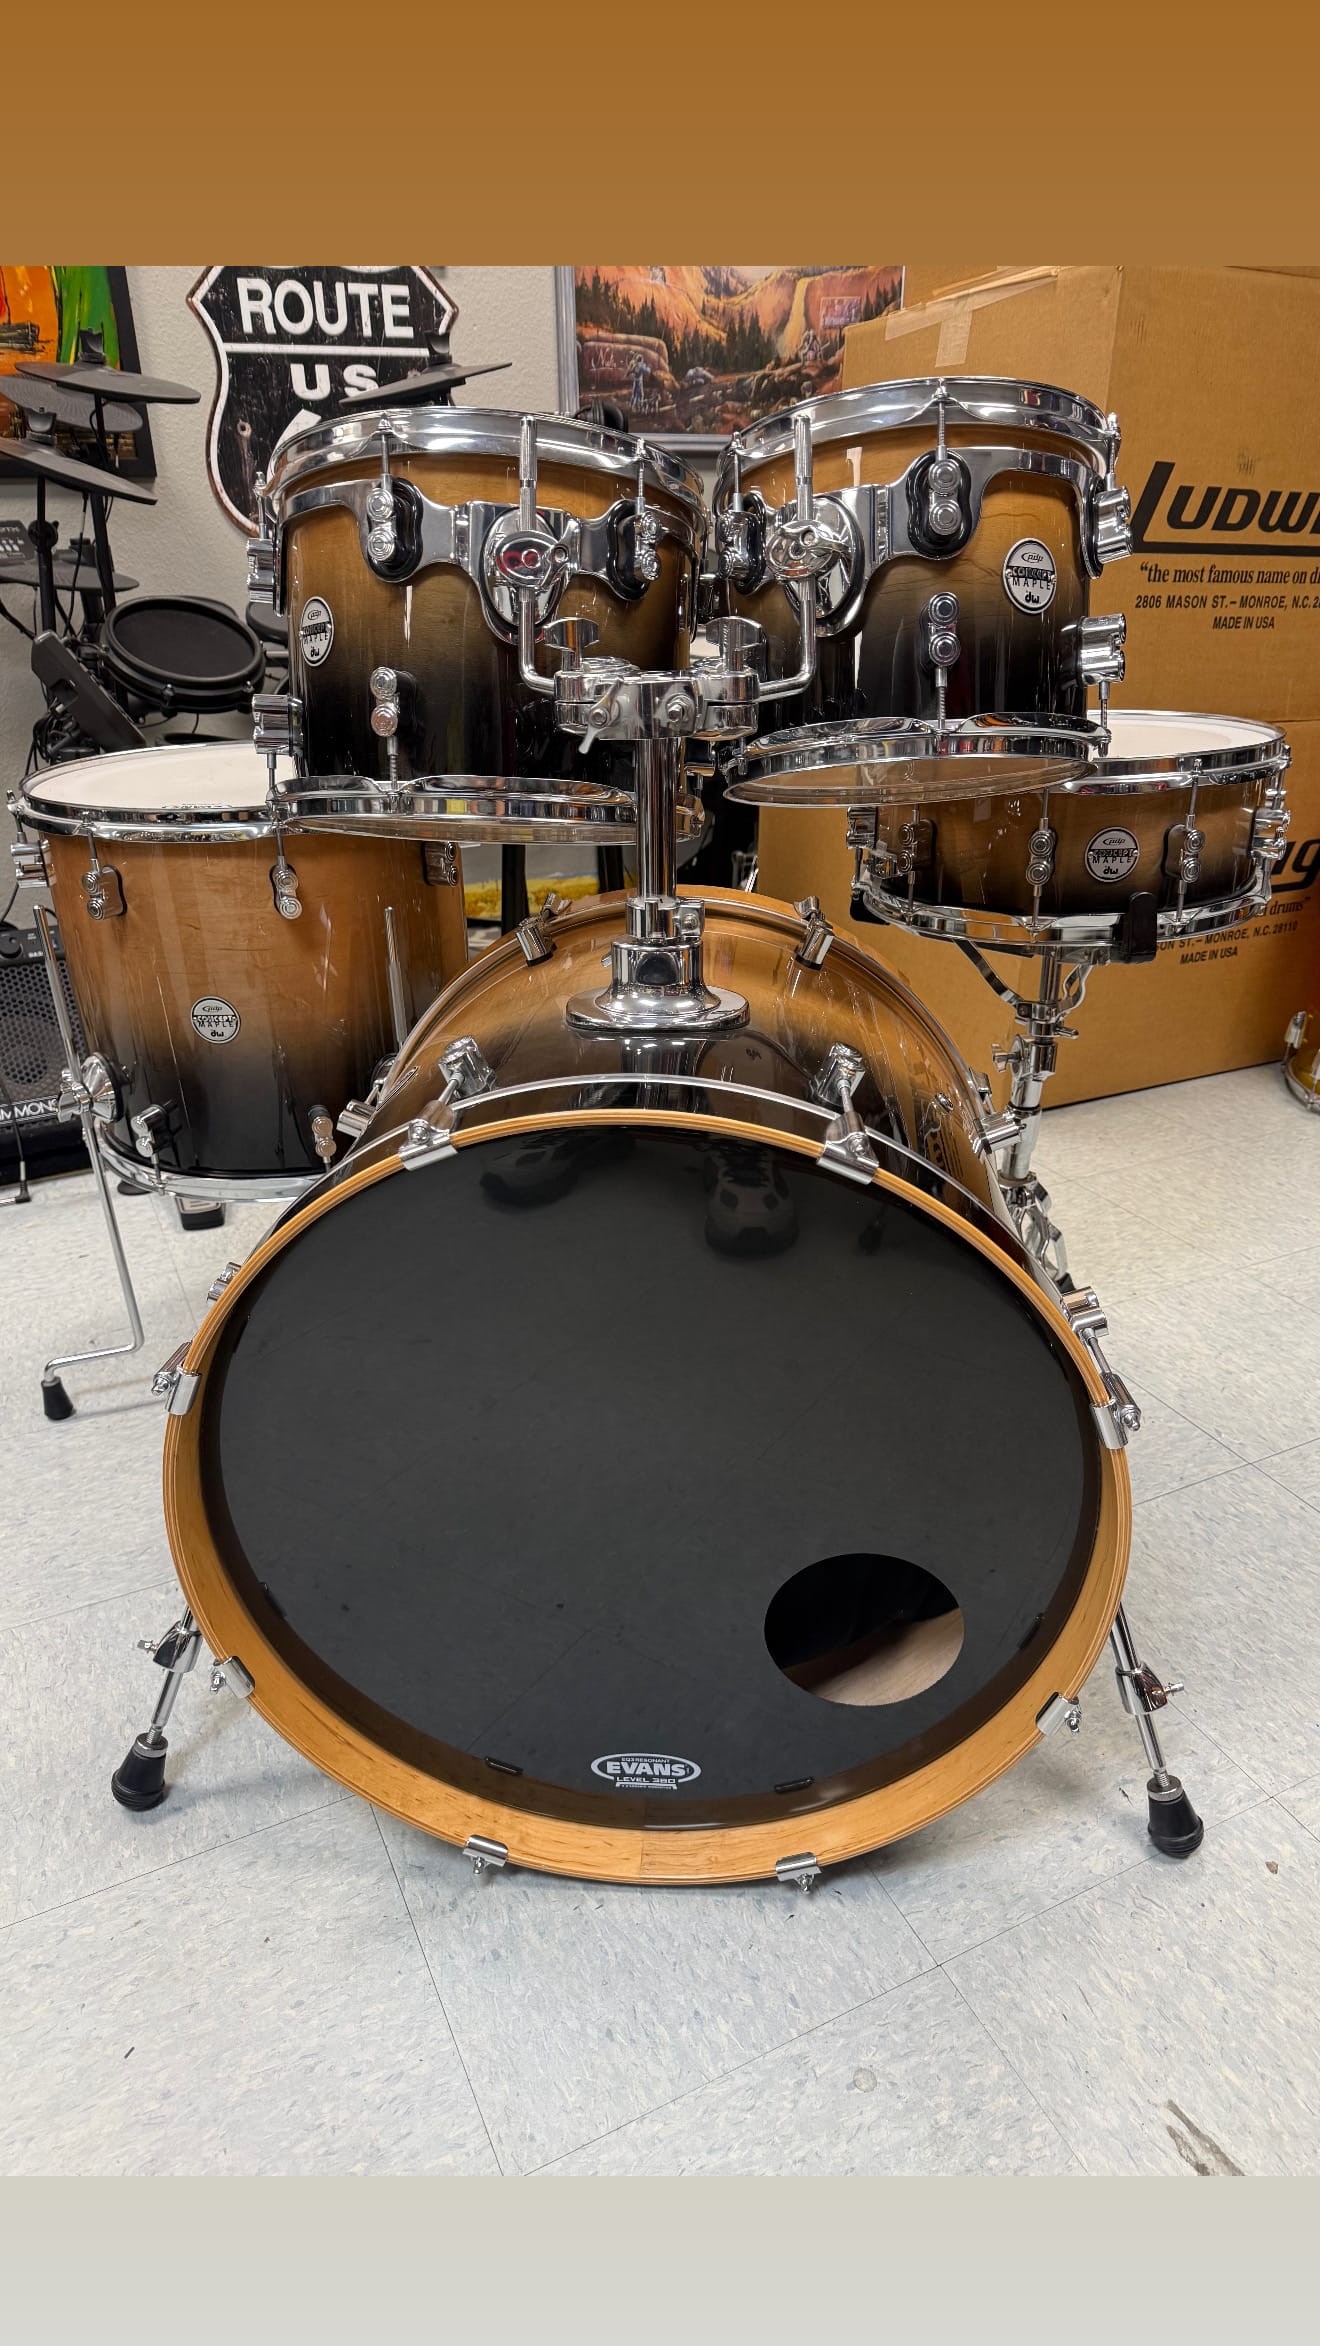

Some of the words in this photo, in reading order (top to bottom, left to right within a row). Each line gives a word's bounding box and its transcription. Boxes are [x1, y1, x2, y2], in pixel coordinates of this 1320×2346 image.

[236, 277, 414, 339] ROUTE
[1172, 566, 1205, 583] most
[1207, 563, 1254, 584] famous
[1256, 570, 1290, 584] name
[1292, 570, 1308, 584] on
[1012, 577, 1052, 590] MAPLE
[1024, 591, 1040, 603] dw
[1134, 595, 1162, 609] 2806
[1166, 595, 1207, 609] MASON
[1239, 595, 1288, 612] MONROE,
[1212, 616, 1242, 629] MADE
[1243, 616, 1254, 629] IN
[1255, 616, 1275, 629] USA
[1092, 856, 1133, 864] MAPLE
[1103, 865, 1118, 874] dw
[1180, 951, 1208, 964] MADE
[1208, 949, 1220, 961] IN
[1220, 946, 1238, 959] USA
[606, 1760, 685, 1776] EVANS
